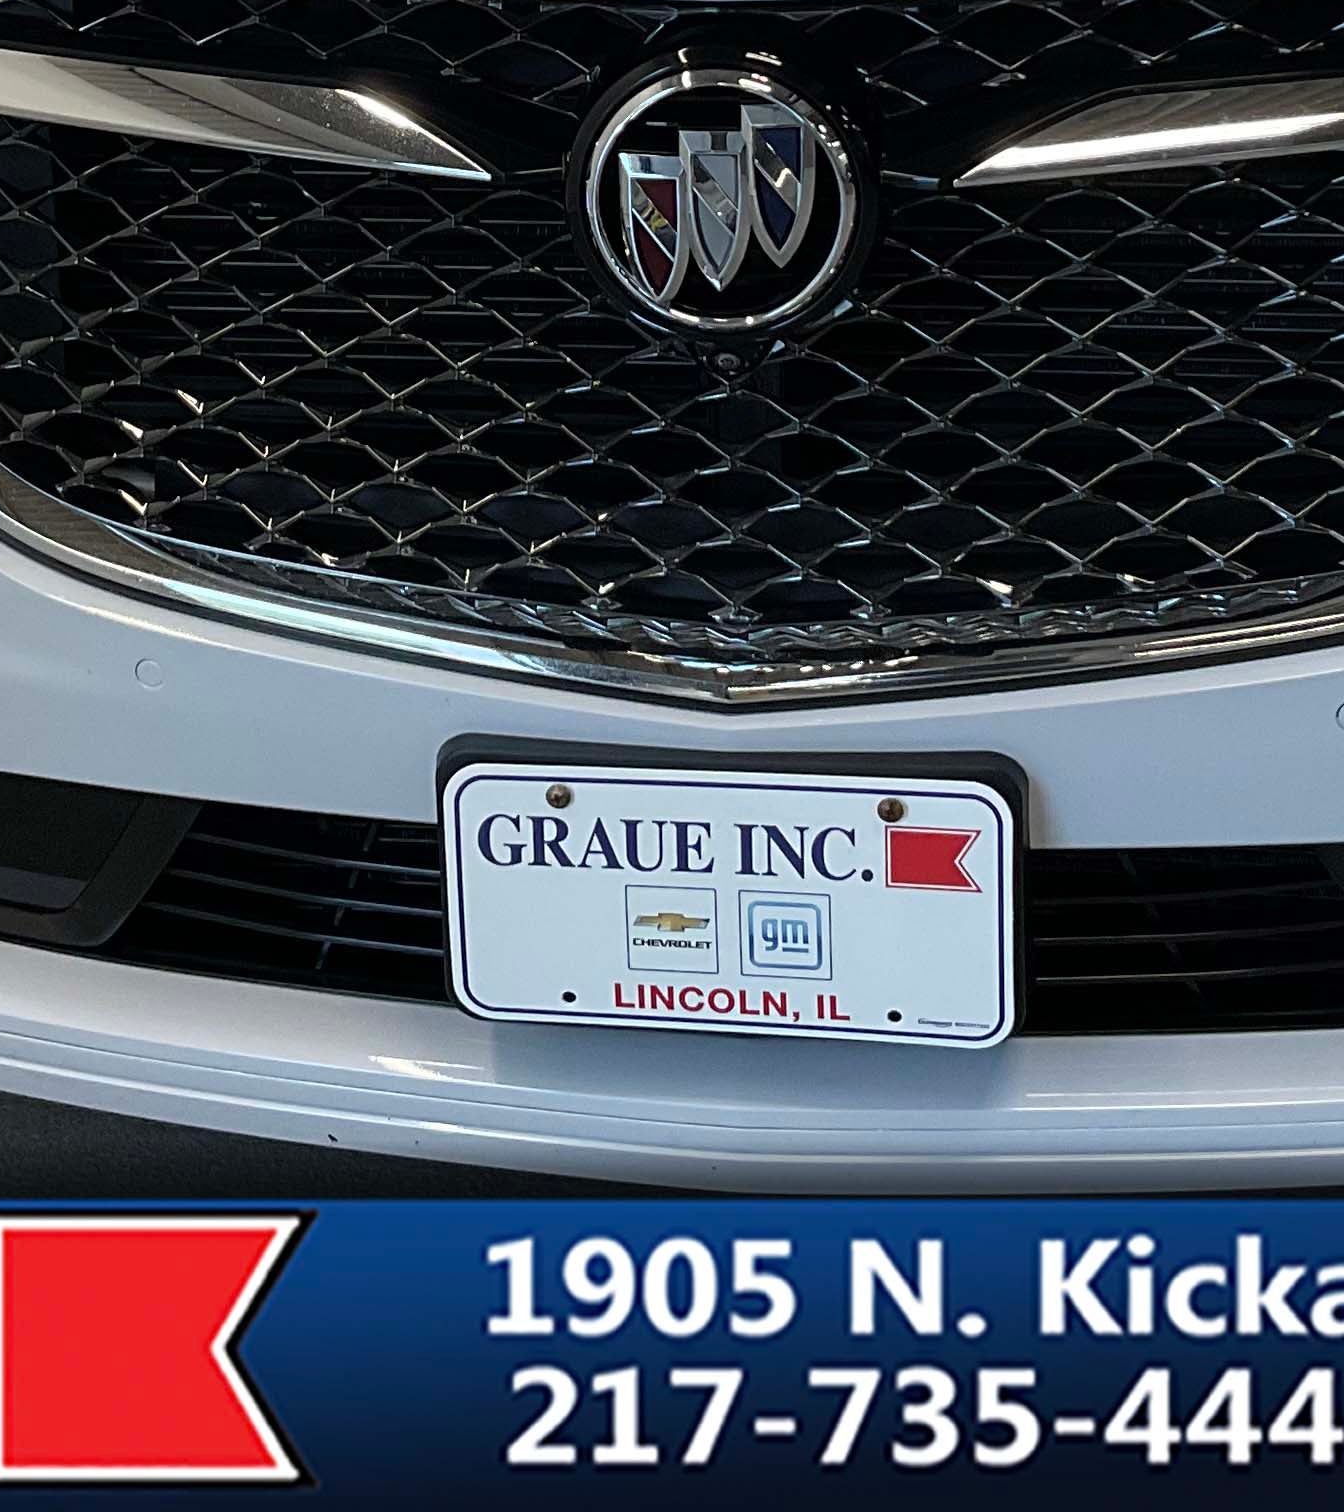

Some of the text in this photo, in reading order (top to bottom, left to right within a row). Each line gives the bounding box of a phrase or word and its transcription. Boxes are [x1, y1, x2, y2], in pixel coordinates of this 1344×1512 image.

[477, 813, 874, 882] GRAUE INC.
[632, 937, 712, 951] CHEVROLET
[614, 983, 850, 1022] LINCOLN, IL
